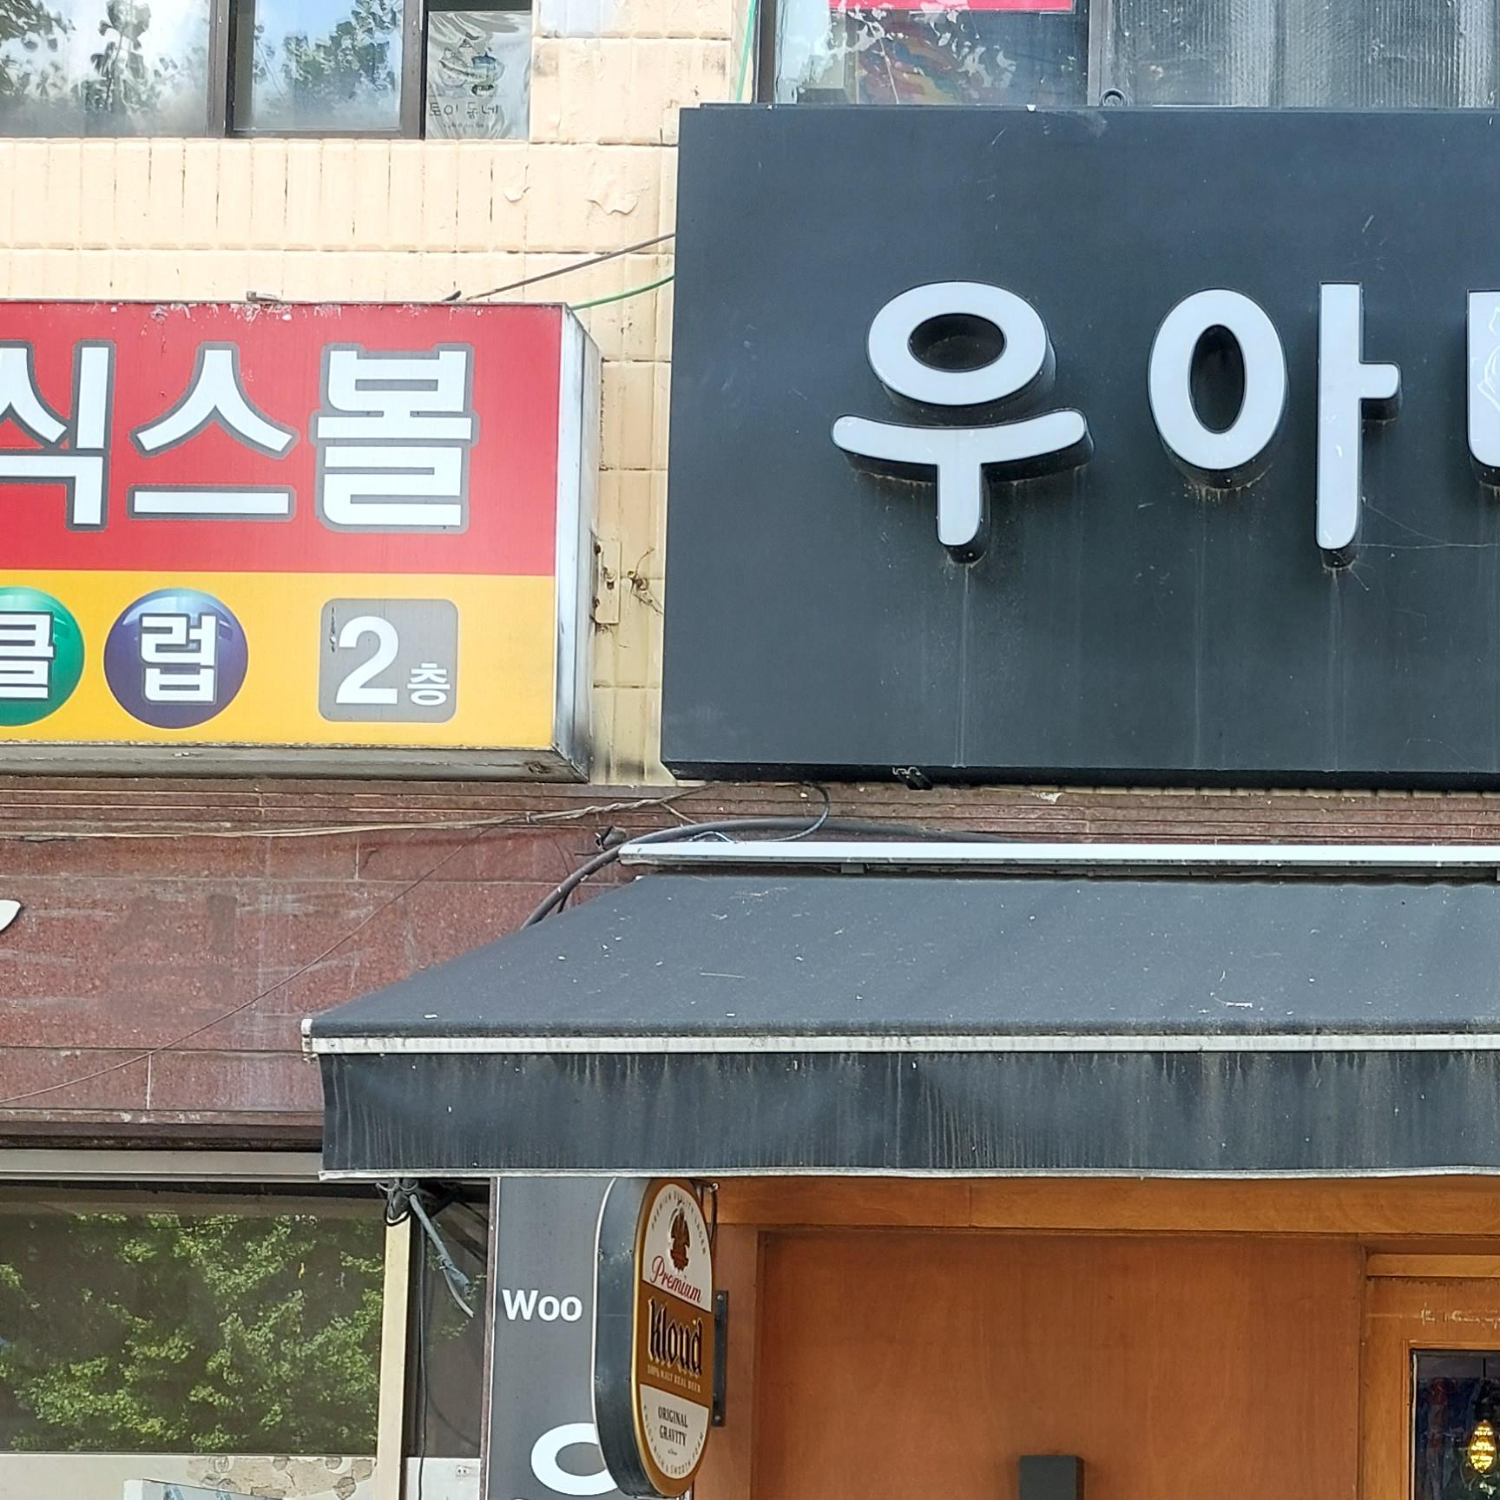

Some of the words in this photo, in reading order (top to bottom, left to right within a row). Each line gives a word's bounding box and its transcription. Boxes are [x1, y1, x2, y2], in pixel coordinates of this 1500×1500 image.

[650, 1255, 702, 1303] Premium
[502, 1290, 583, 1324] Woo
[657, 1406, 688, 1430] ORIGINAL
[659, 1425, 687, 1447] GRAVITY
